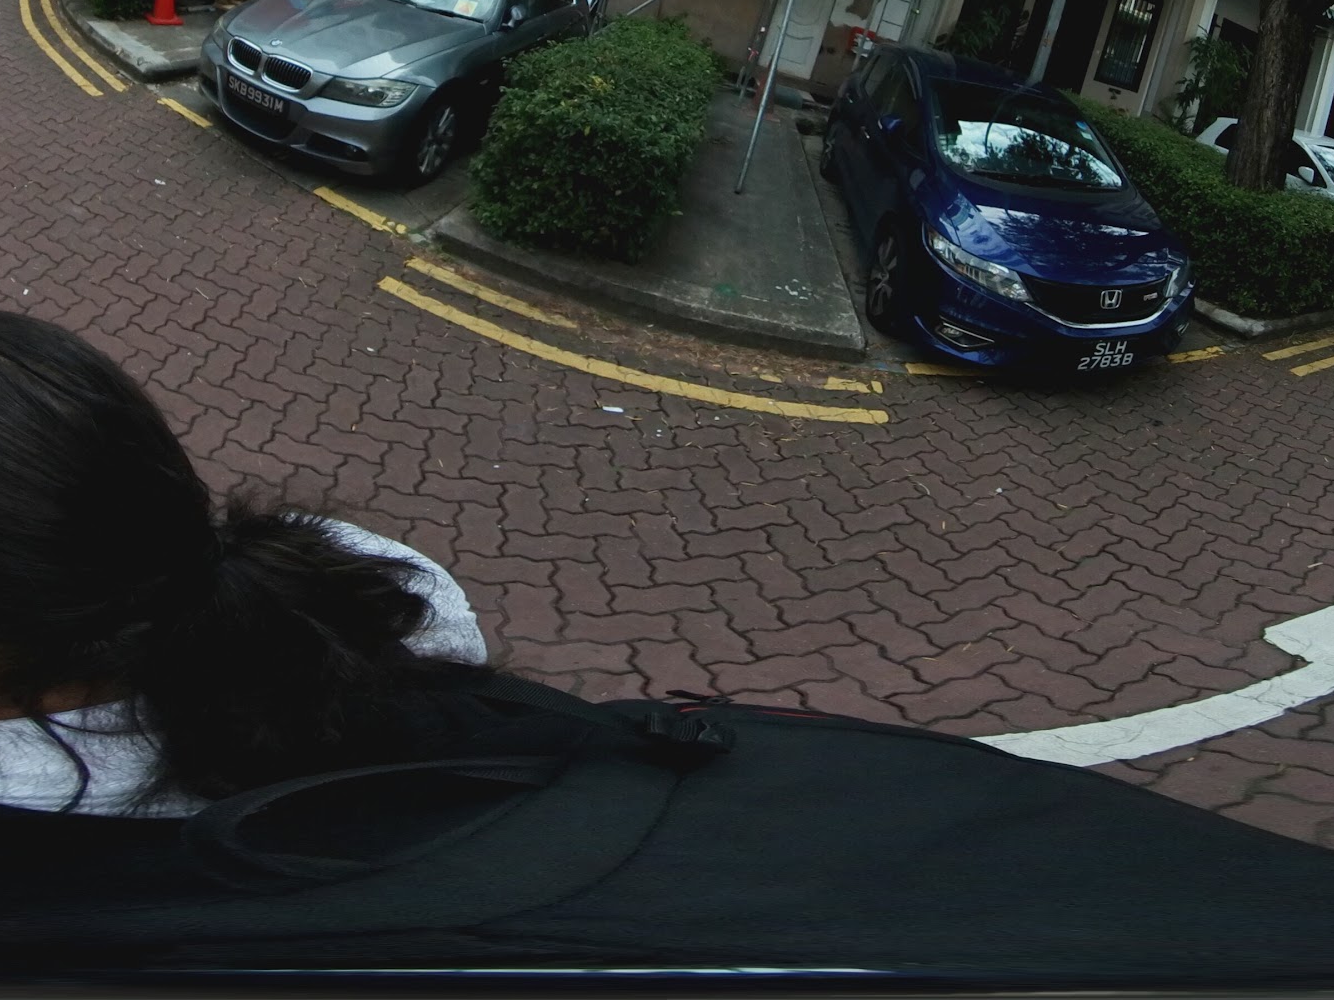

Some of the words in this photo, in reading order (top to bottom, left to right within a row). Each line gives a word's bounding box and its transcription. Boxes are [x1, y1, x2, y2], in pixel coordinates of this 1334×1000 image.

[228, 75, 284, 113] SKB9931M
[1093, 340, 1127, 356] SLH
[1077, 353, 1134, 370] 2783B
